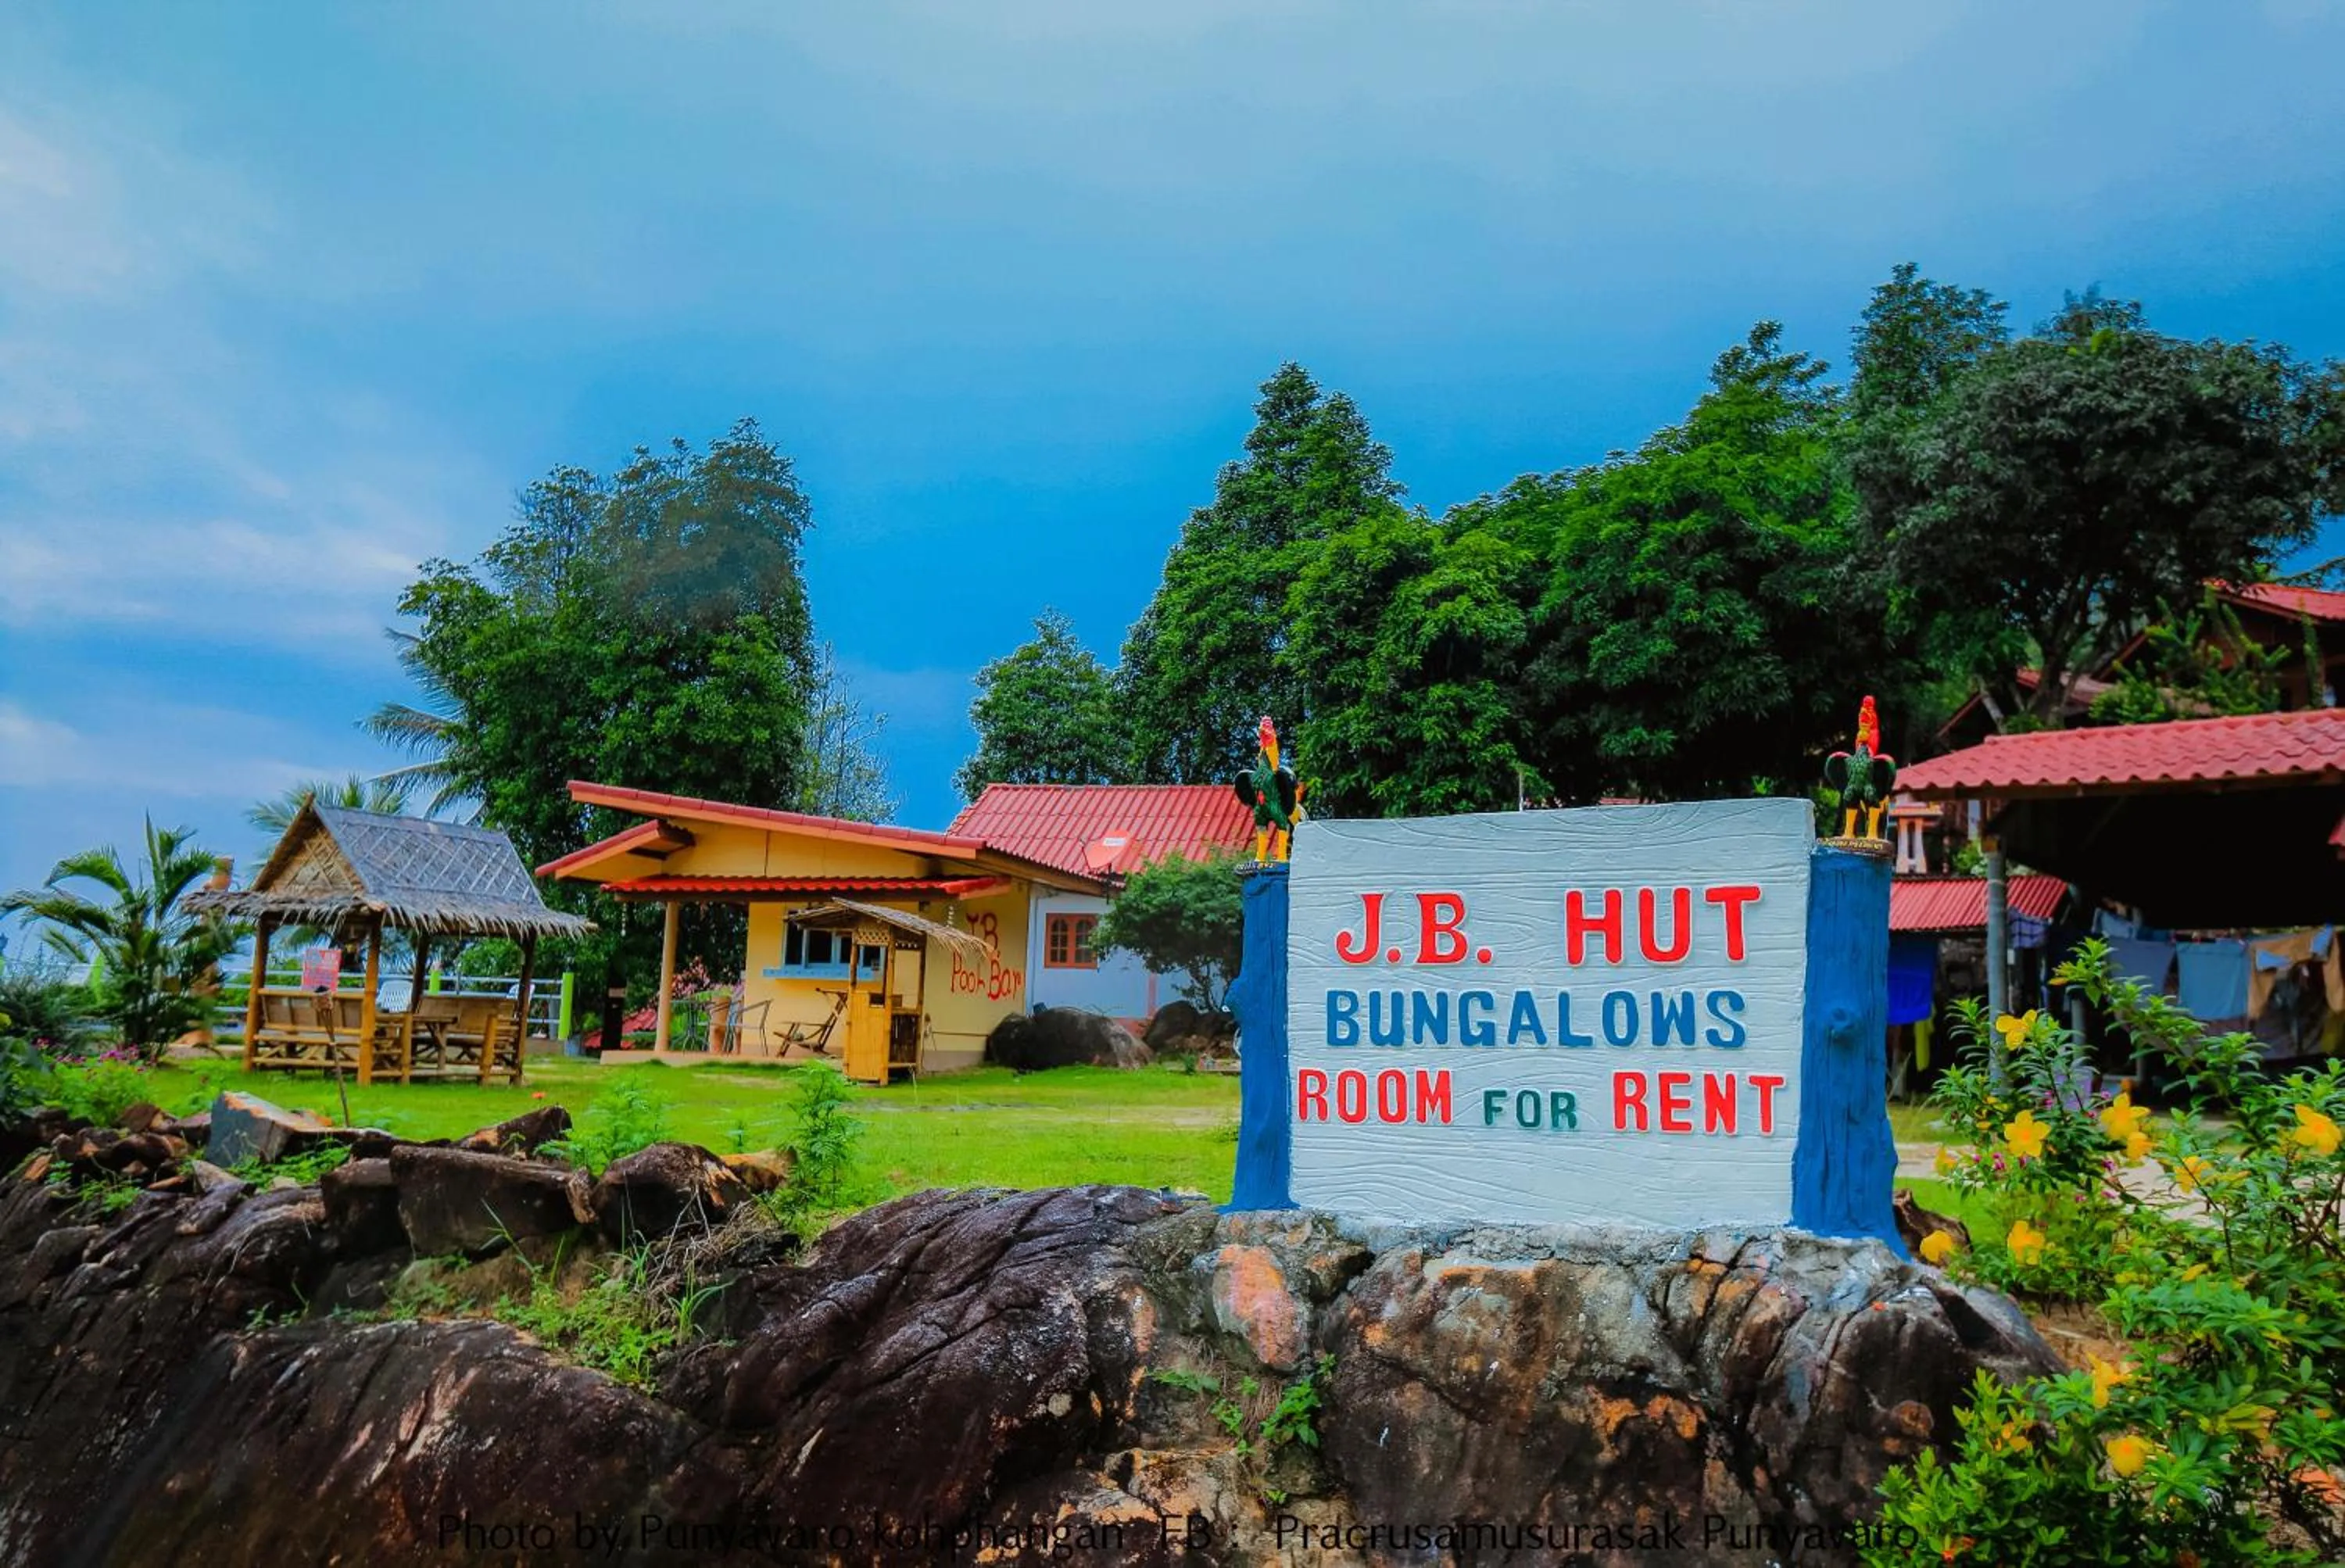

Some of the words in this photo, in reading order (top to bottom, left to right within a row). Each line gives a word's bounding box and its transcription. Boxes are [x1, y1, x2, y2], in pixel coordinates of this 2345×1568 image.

[1335, 891, 1494, 965] J.B.
[1565, 885, 1762, 965] HUT
[1325, 990, 1747, 1049] BUNGALOWS
[1298, 1068, 1452, 1123] ROOM
[1483, 1089, 1577, 1129] FOR
[1612, 1071, 1786, 1134] RENT
